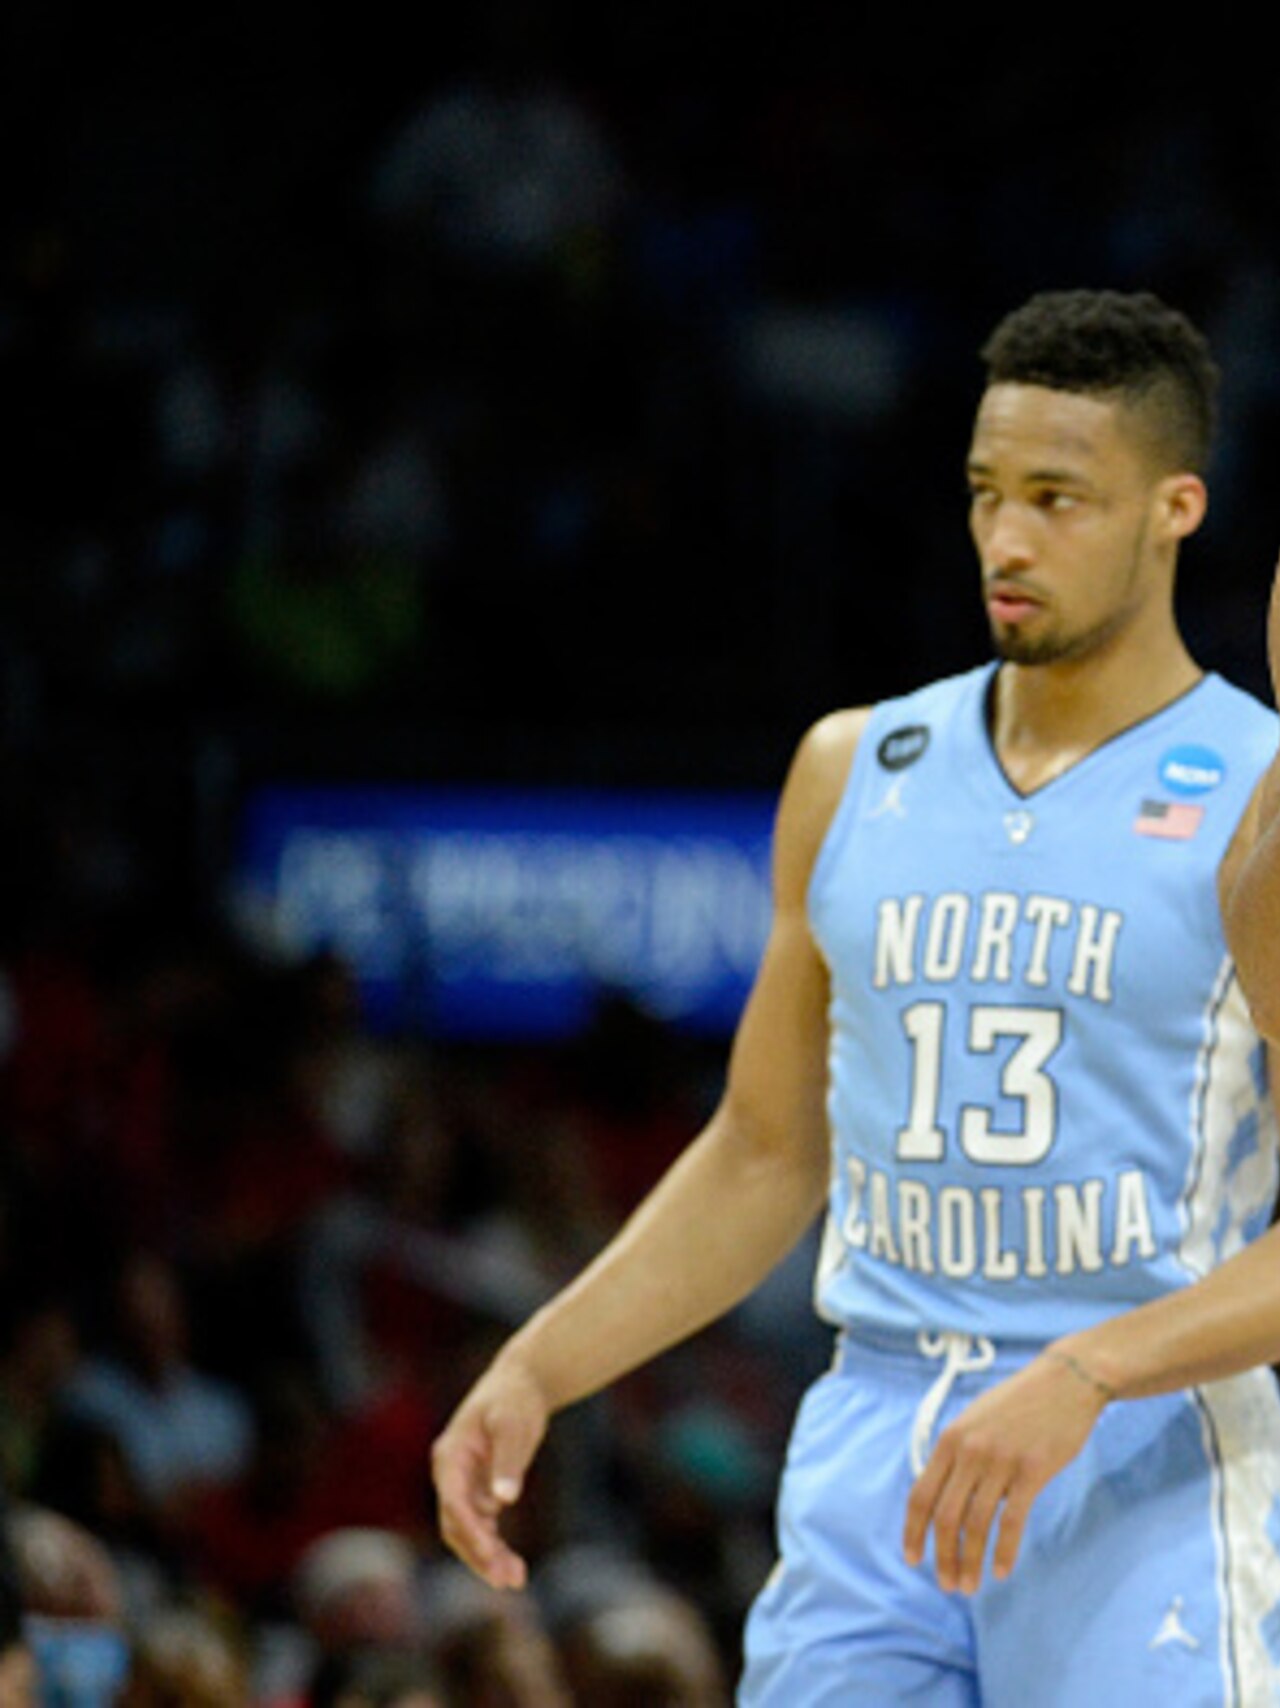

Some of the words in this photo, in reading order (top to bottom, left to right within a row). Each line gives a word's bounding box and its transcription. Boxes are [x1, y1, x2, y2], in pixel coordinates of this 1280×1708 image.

[873, 892, 1122, 1002] NORTH
[896, 1001, 1065, 1167] 13
[842, 1155, 1156, 1280] CAROLINA
